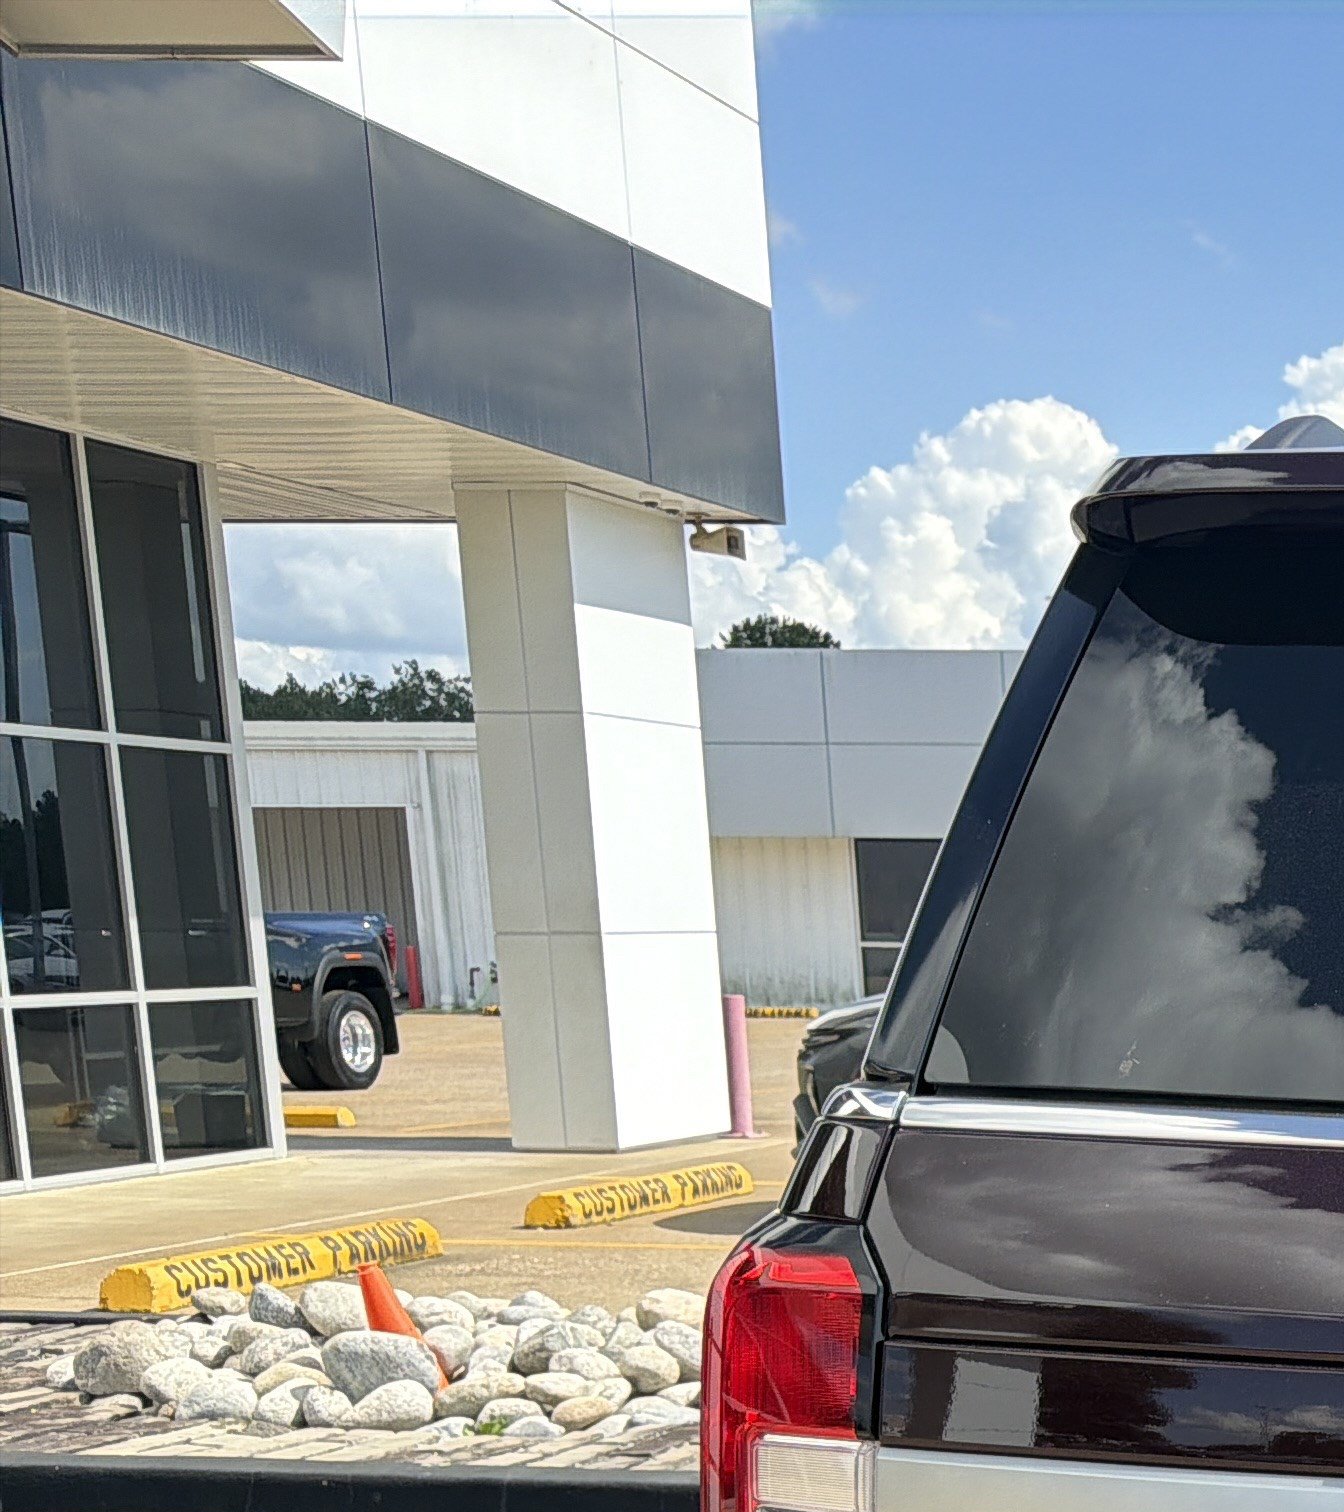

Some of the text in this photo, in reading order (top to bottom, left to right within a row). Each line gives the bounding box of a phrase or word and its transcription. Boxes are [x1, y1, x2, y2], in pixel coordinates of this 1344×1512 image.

[572, 1165, 743, 1219] CUSTOMER PARKING
[164, 1220, 427, 1298] CUSTOMER PARKING
